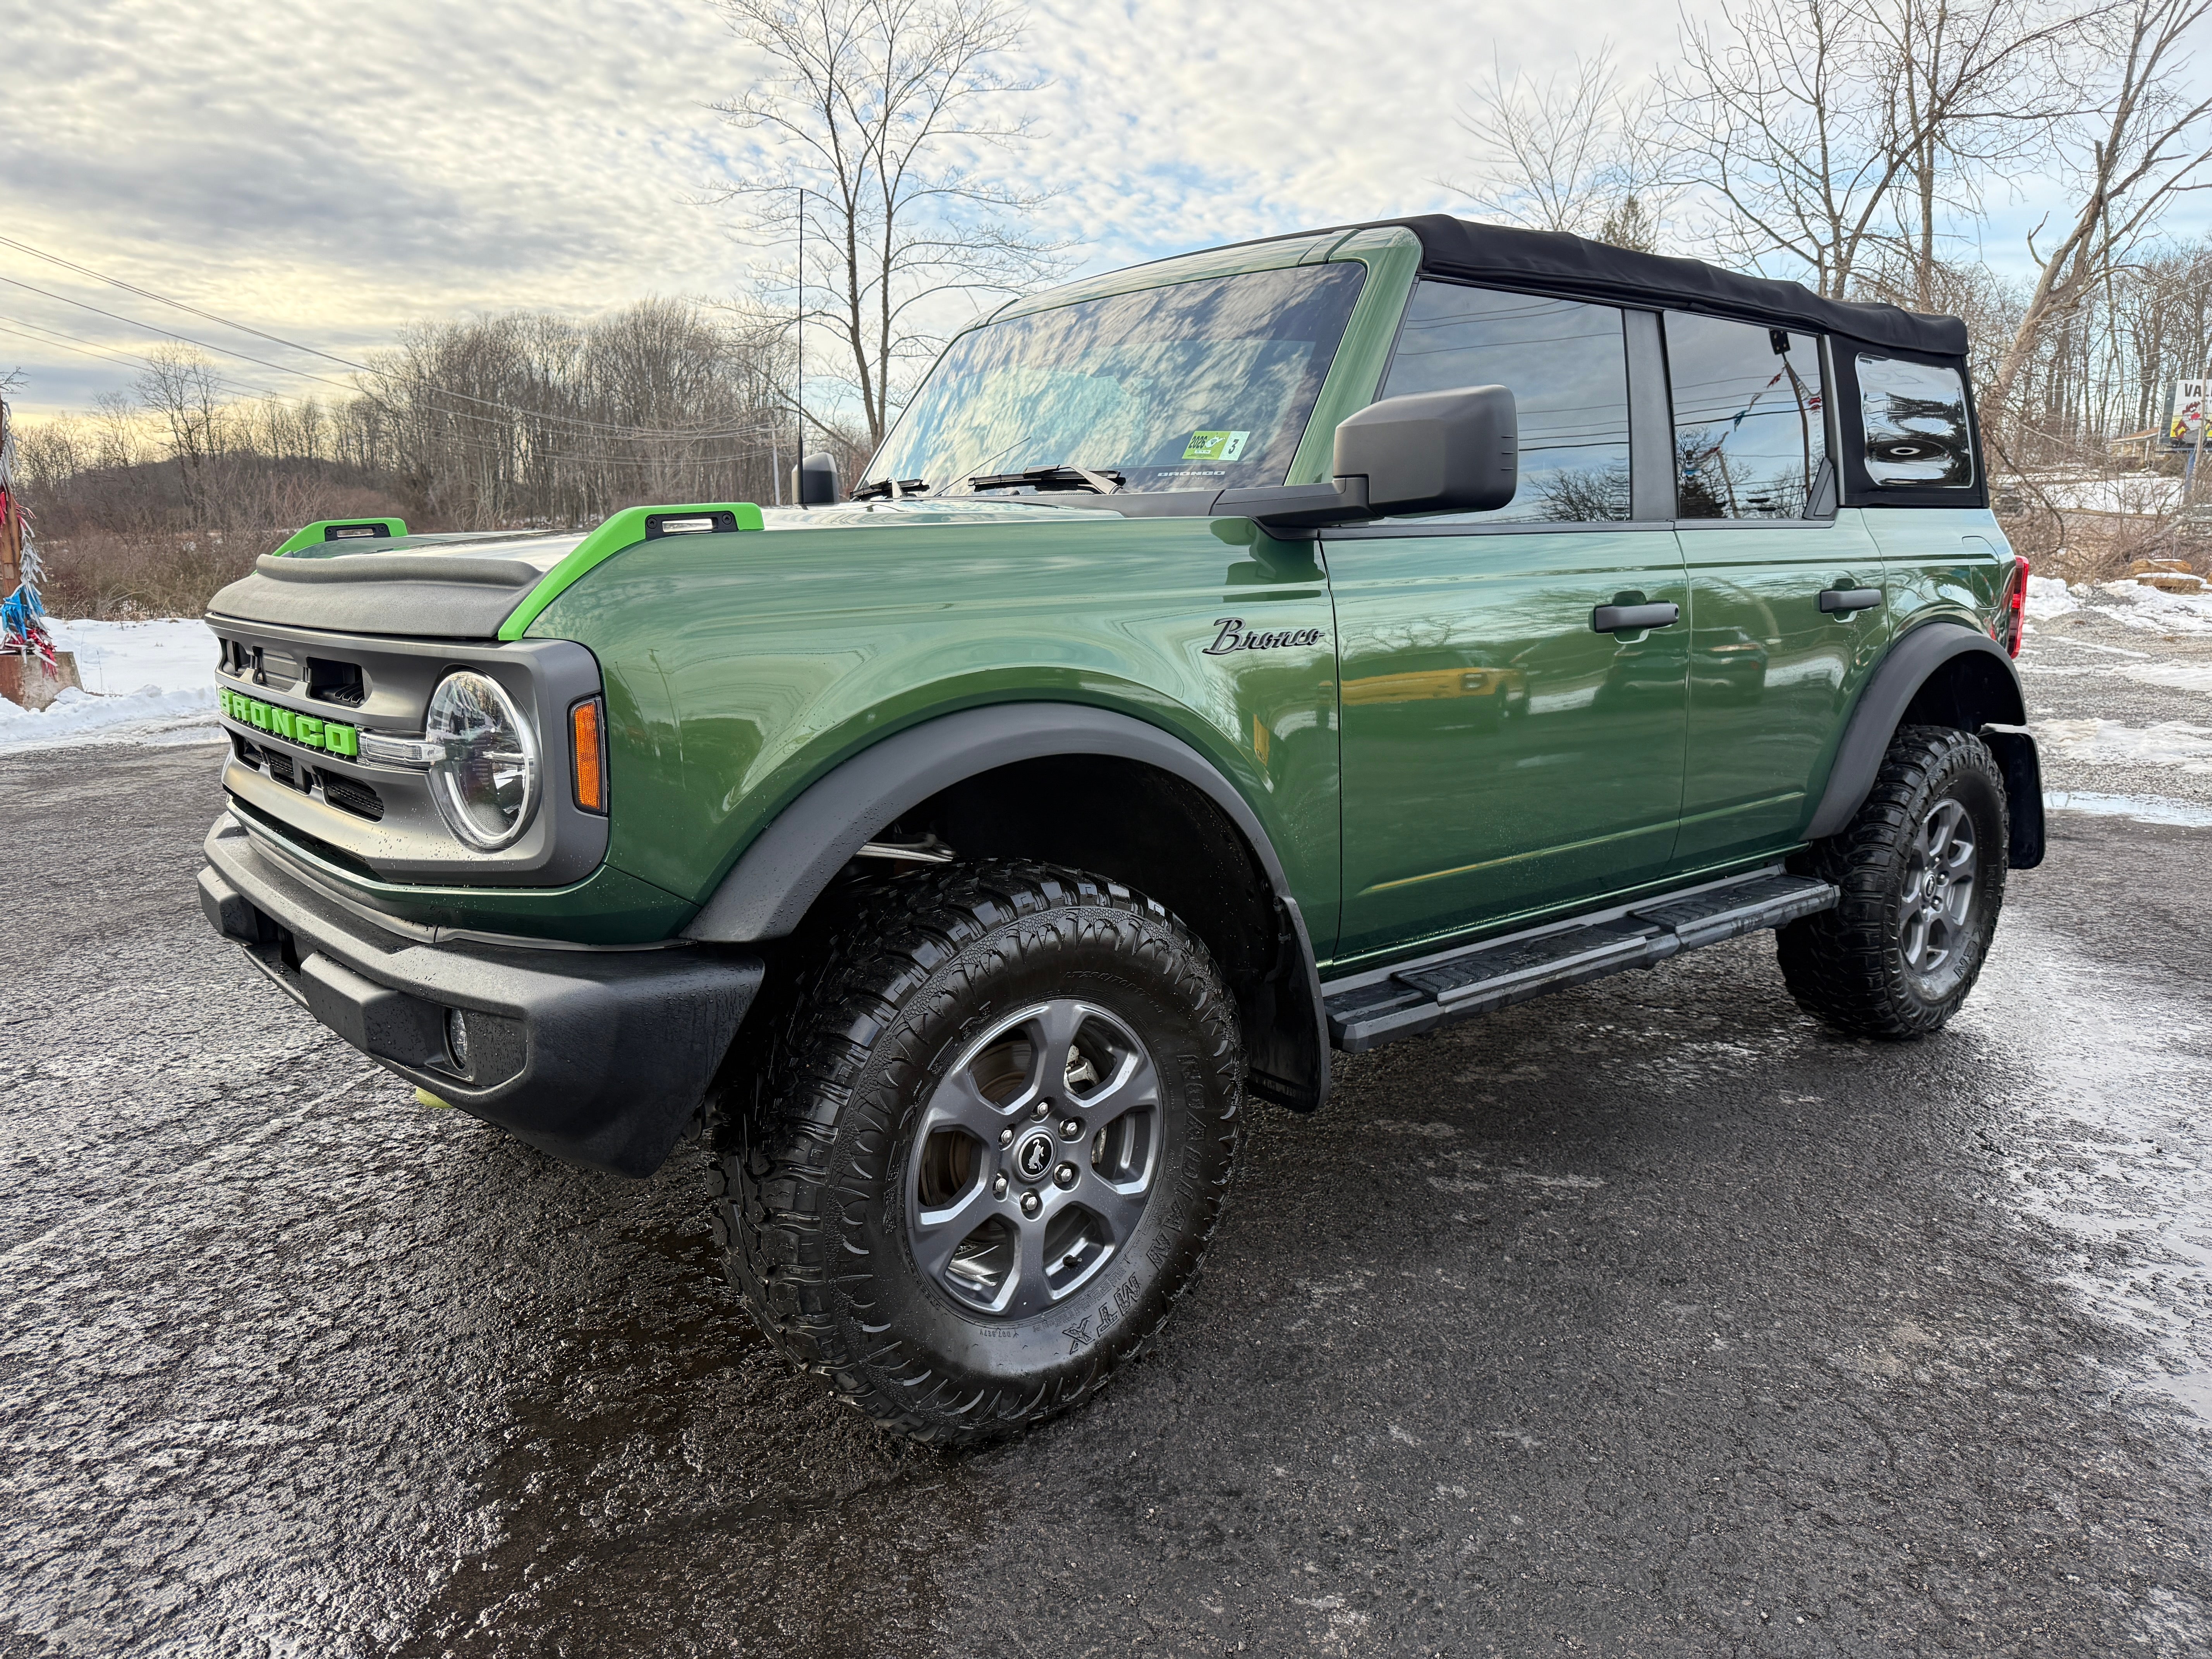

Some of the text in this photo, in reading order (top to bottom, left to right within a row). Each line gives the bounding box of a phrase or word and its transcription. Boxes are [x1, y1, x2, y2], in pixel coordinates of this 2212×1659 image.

[1188, 435, 1207, 449] 2026
[1228, 439, 1239, 454] 3
[1202, 617, 1325, 655] Bronco
[219, 686, 358, 756] BRONCO
[1146, 1054, 1207, 1273] ROADIAN
[1062, 1271, 1141, 1355] MTX
